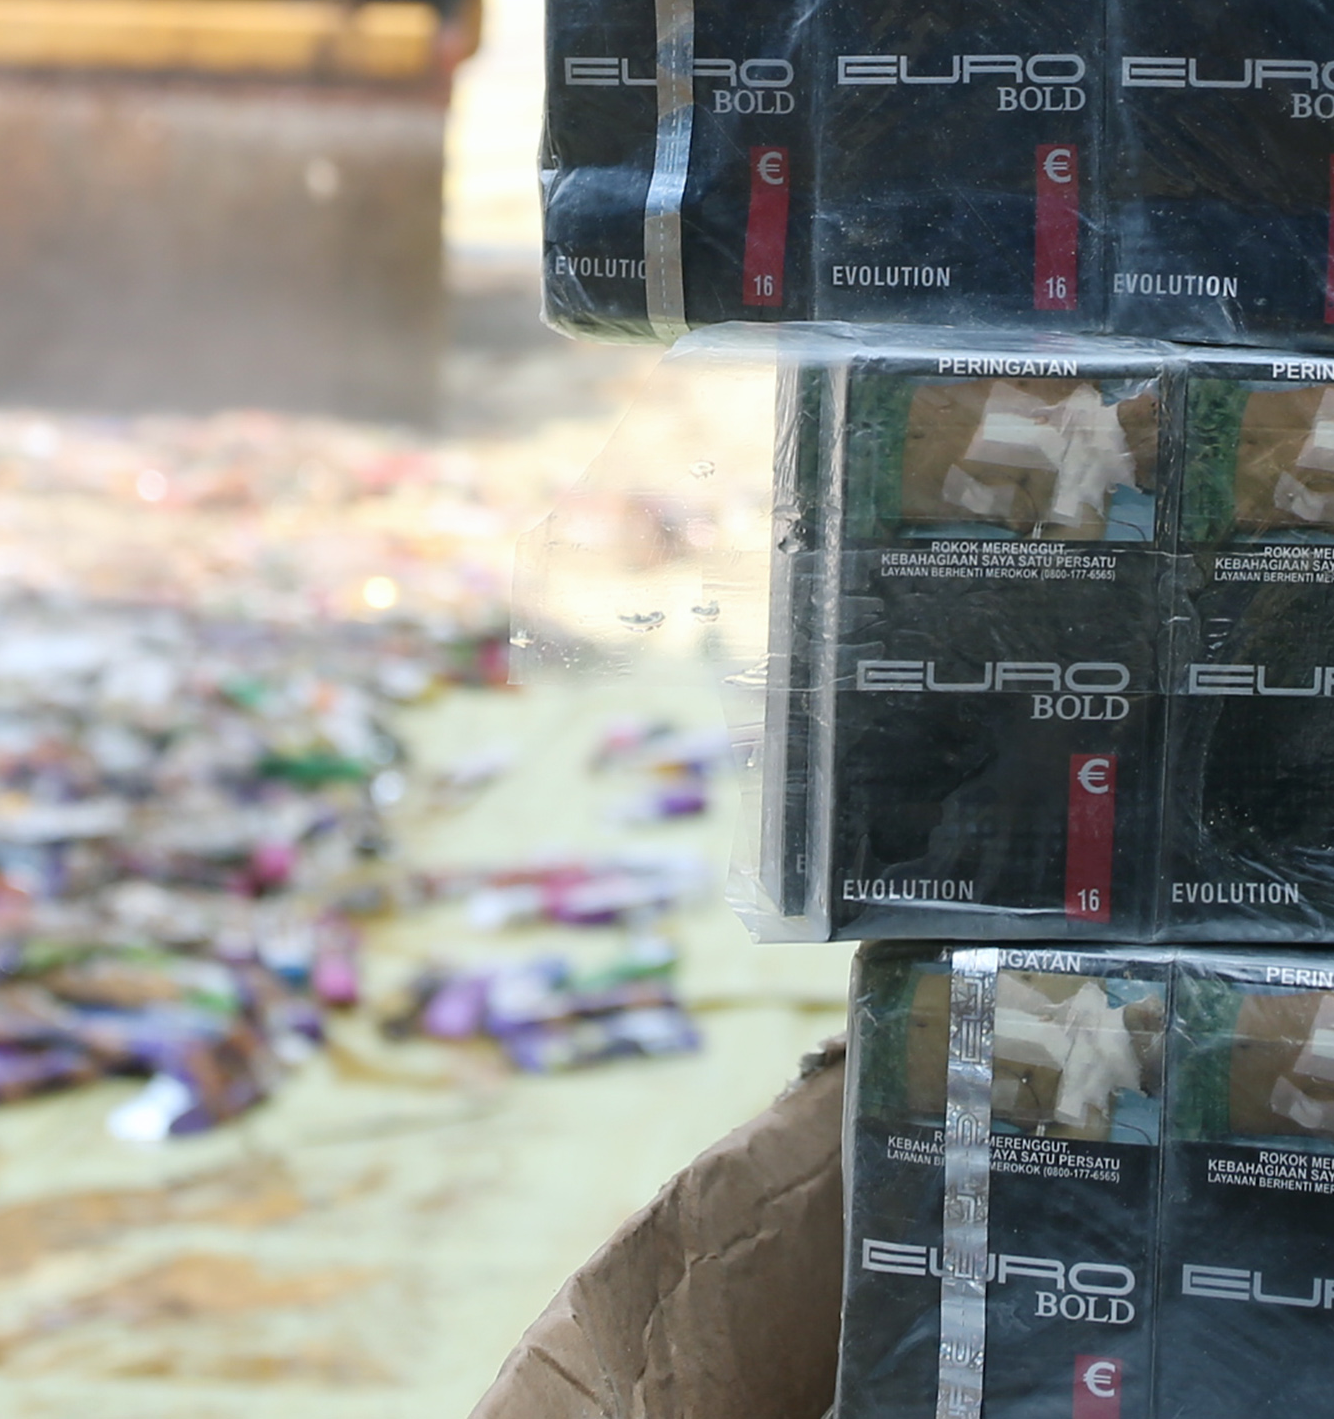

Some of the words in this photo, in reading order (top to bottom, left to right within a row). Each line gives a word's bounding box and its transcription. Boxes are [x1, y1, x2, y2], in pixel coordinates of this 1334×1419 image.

[838, 54, 1085, 84] EURO
[712, 90, 795, 114] BOLD
[997, 86, 1085, 111] BOLD
[754, 275, 772, 296] 16
[832, 266, 951, 287] EVOLUTION
[1113, 273, 1237, 298] EVOLUTION
[1046, 276, 1066, 299] 16
[939, 358, 1077, 376] PERINGATAN
[932, 542, 978, 553] ROKOK
[1264, 547, 1309, 558] ROKOK
[881, 554, 977, 565] KEBAHAGIAAN
[982, 555, 1015, 566] SAYA
[1019, 555, 1051, 566] SATU
[1056, 556, 1116, 568] PERSATU
[1215, 558, 1309, 570] KEBAHAGIAAN
[881, 568, 928, 577] LAYANAN
[931, 568, 983, 578] BERHENTI
[986, 569, 1038, 579] MEROKOK
[1215, 572, 1260, 581] LAYANAN
[1263, 572, 1313, 582] BERHENTI
[857, 660, 1130, 693] EURO
[1031, 695, 1129, 720] BOLD
[843, 879, 973, 901] EVOLUTION
[1077, 889, 1099, 911] 16
[1172, 883, 1299, 904] EVOLUTION
[887, 1150, 931, 1165] LAYANAN
[990, 1162, 1040, 1176] MEROKOK
[1021, 1151, 1056, 1165] SATU
[1059, 1155, 1120, 1171] PERSATU
[1208, 1159, 1307, 1179] KEBAHAGIAAN
[1259, 1151, 1307, 1166] ROKOK
[1208, 1173, 1256, 1186] LAYANAN
[1259, 1177, 1312, 1192] BERHENTI
[1035, 1291, 1135, 1324] BOLD
